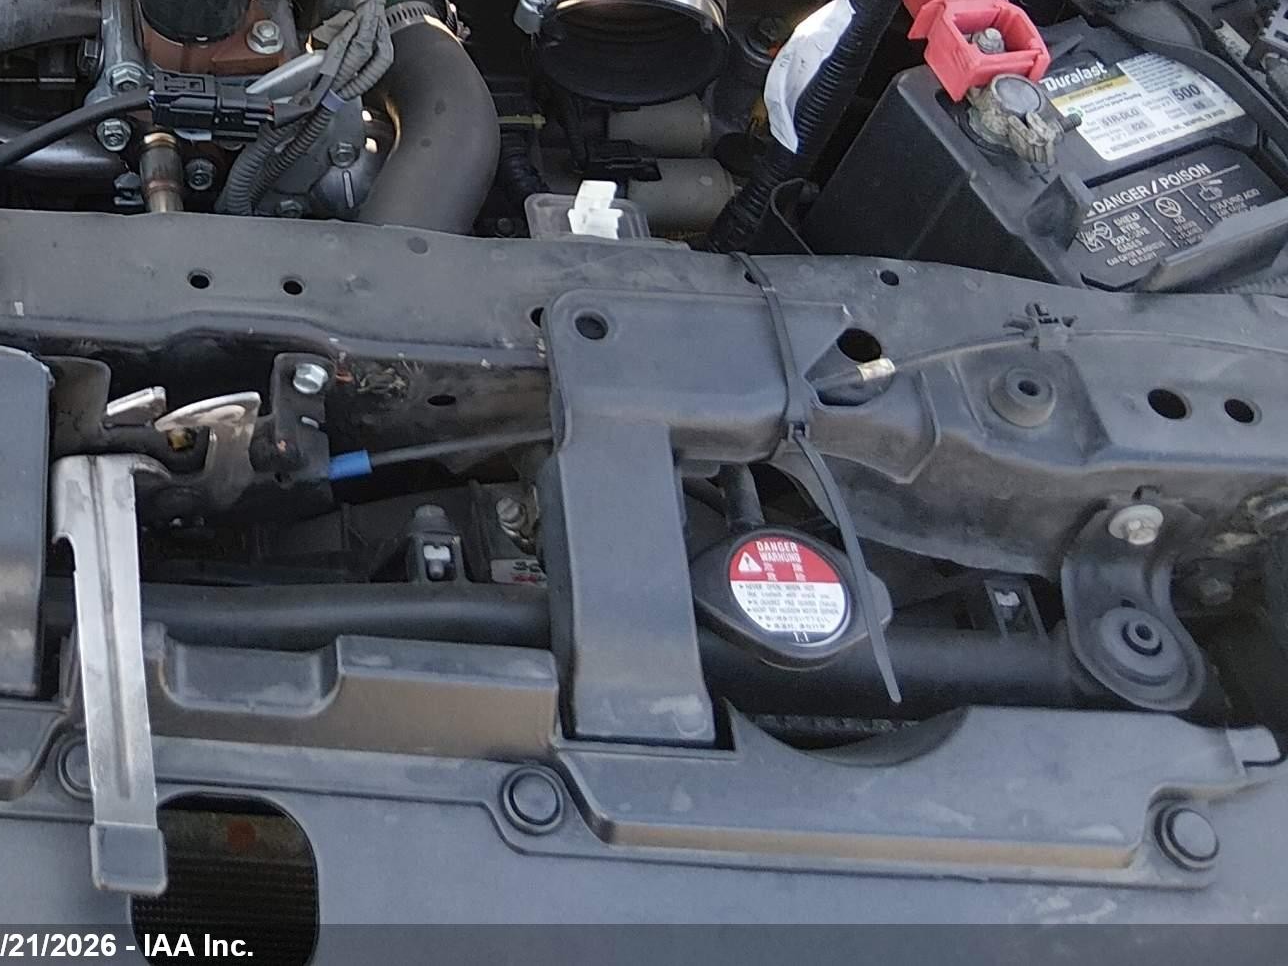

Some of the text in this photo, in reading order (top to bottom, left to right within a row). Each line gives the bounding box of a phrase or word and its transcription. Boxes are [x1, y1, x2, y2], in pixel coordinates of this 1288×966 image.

[1039, 60, 1108, 92] Duralast
[1173, 84, 1202, 102] 500
[1092, 184, 1152, 215] DANGER
[1158, 162, 1212, 190] POISON
[756, 541, 799, 552] DANGER
